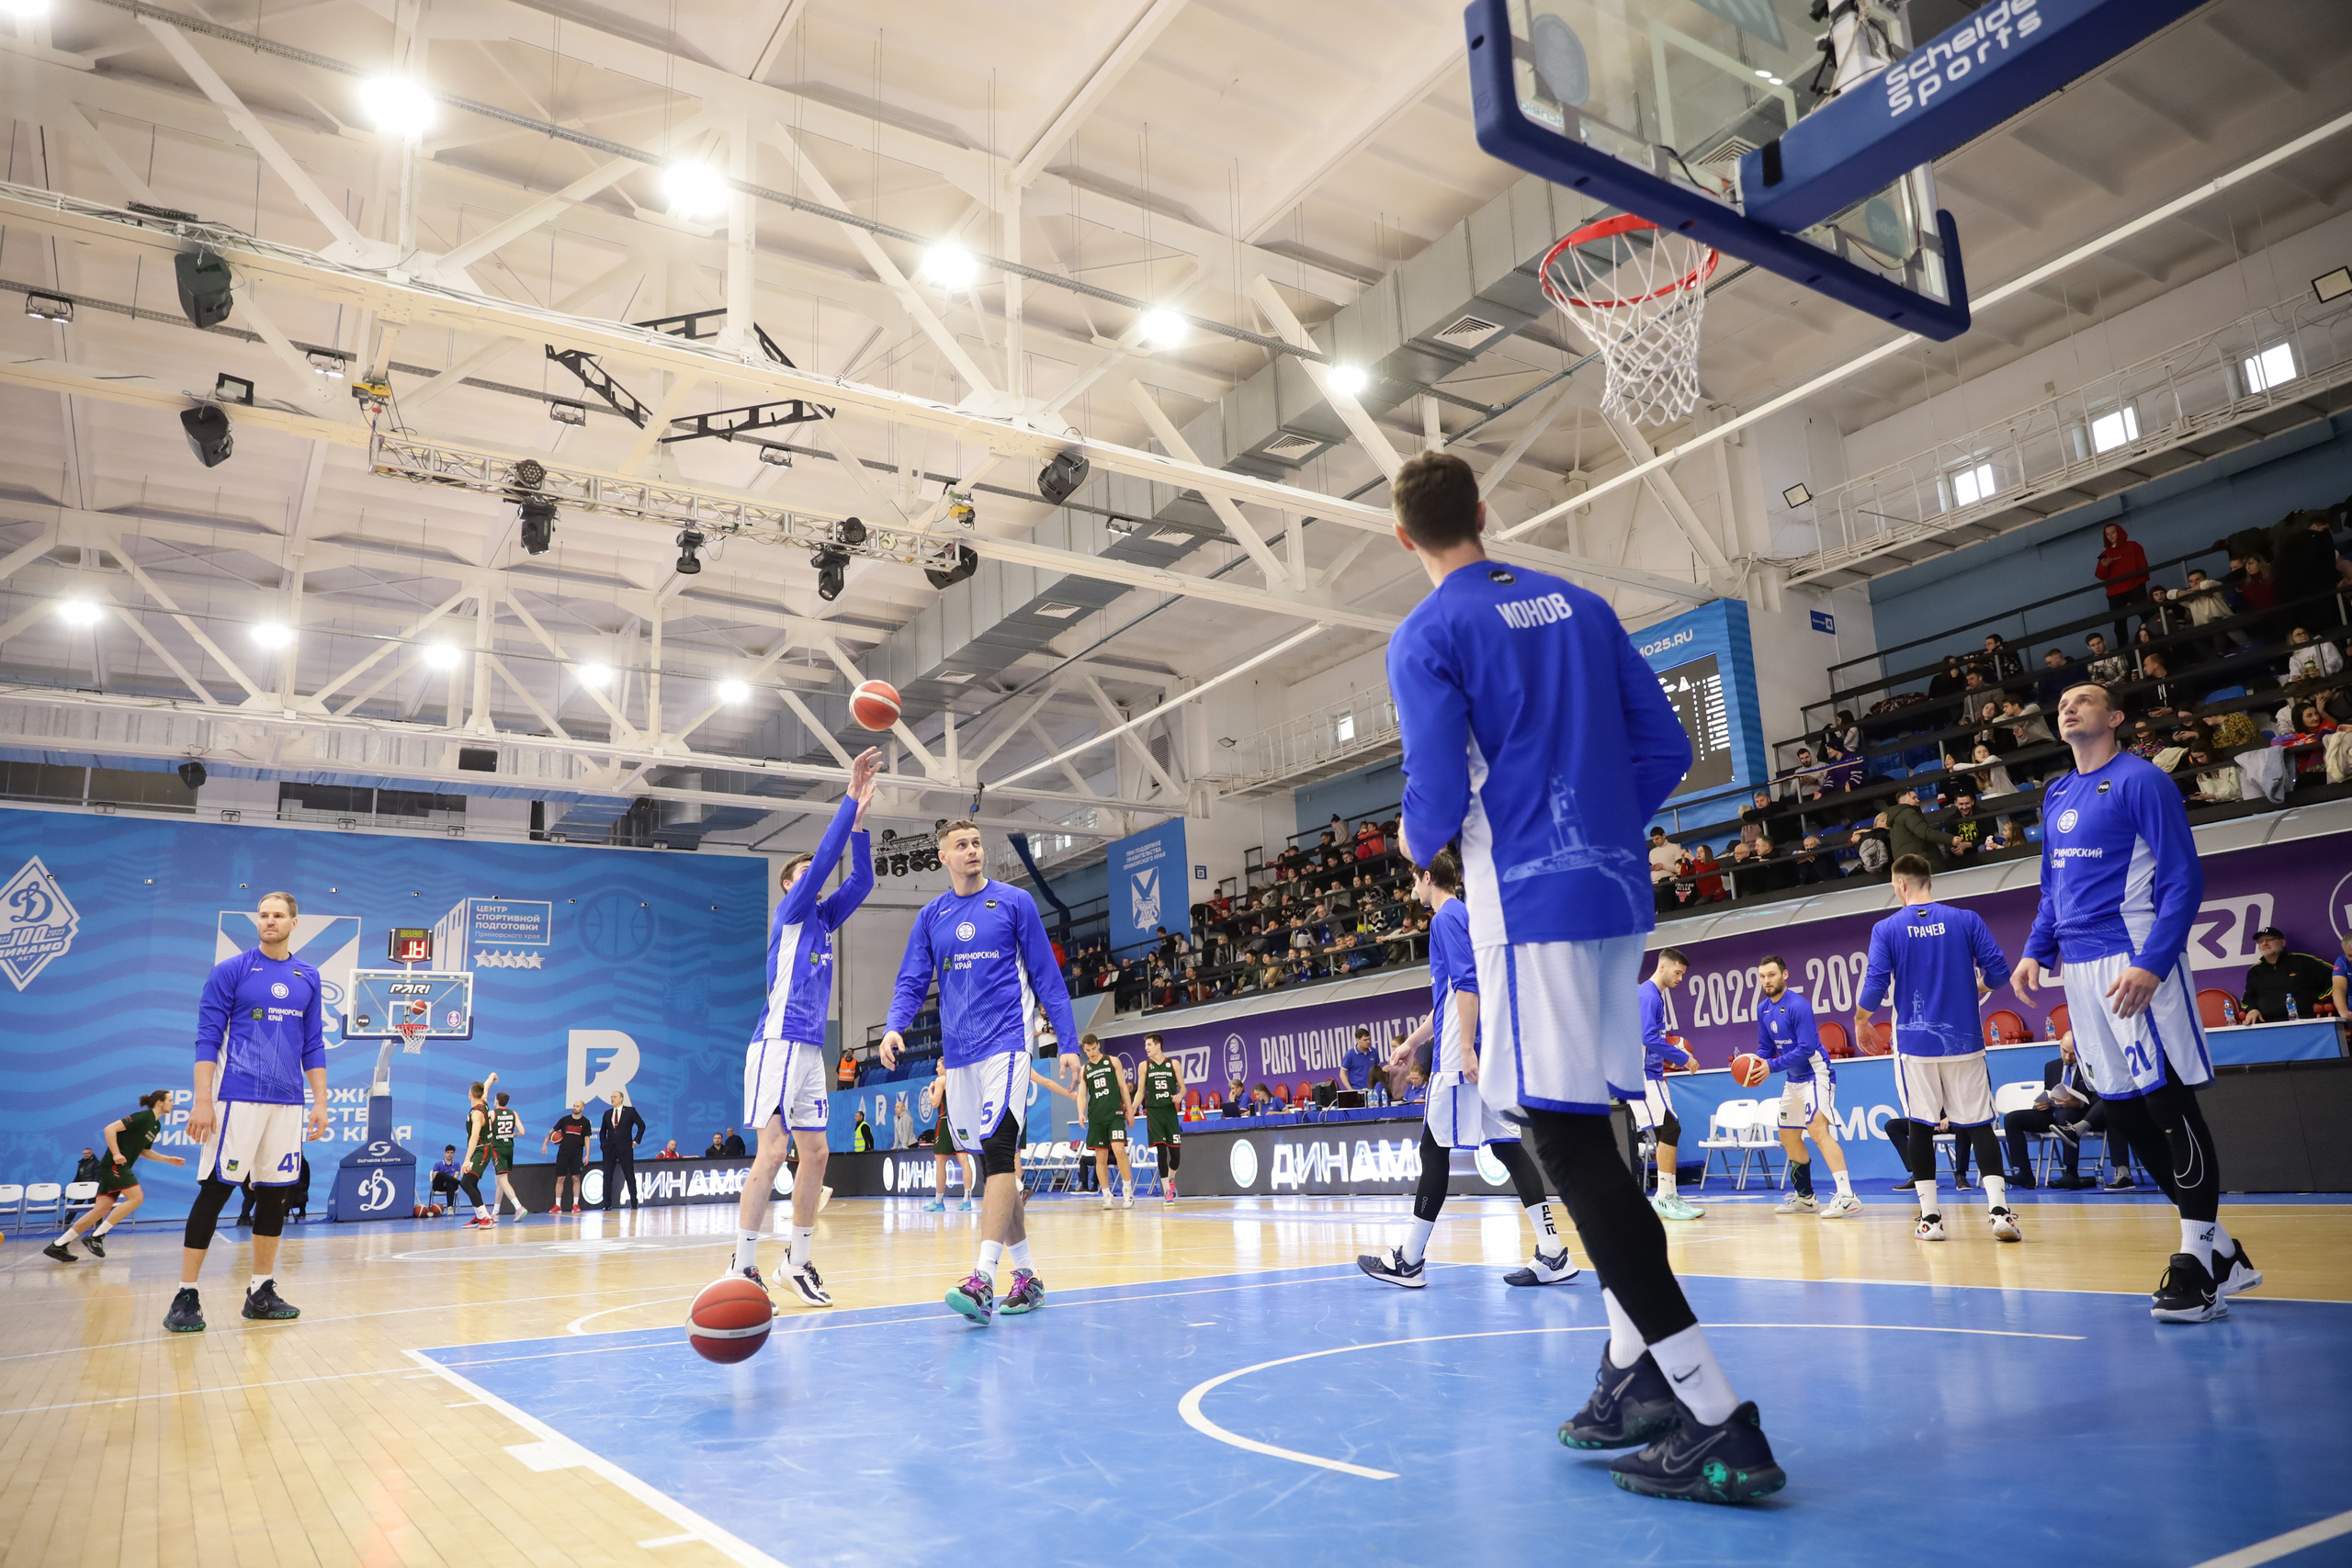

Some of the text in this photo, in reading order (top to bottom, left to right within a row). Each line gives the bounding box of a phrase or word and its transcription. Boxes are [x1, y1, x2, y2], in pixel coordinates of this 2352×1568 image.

[1885, 0, 2037, 96] Schelde
[1887, 10, 2042, 118] Sports
[1495, 592, 1573, 629] ИОНОВ
[2053, 847, 2103, 859] РИМОРСКИЙ
[476, 905, 508, 913] ЦЕНТР
[476, 913, 540, 923] СПОРТИВНОЙ
[475, 921, 538, 931] ПОДГОТОВКИ
[1907, 922, 1946, 938] ГРАЧЕВ
[9, 925, 49, 946] 100
[47, 928, 66, 937] 2023
[474, 931, 523, 940] Приморского
[954, 950, 1000, 962] ПРИМОРСКИЙ
[955, 961, 972, 970] КРАЙ
[389, 983, 432, 994] PARI
[267, 1014, 284, 1022] КРАЙ
[1298, 1018, 1402, 1072] ЧЕМПИНАТ
[2125, 1040, 2153, 1077] 21
[1093, 1077, 1107, 1089] 88
[1155, 1080, 1168, 1089] 55
[343, 1125, 412, 1142] КЯ
[497, 1121, 514, 1134] 22
[1112, 1130, 1125, 1140] 88
[277, 1151, 300, 1173] 41
[897, 1159, 956, 1193] ДИНАО
